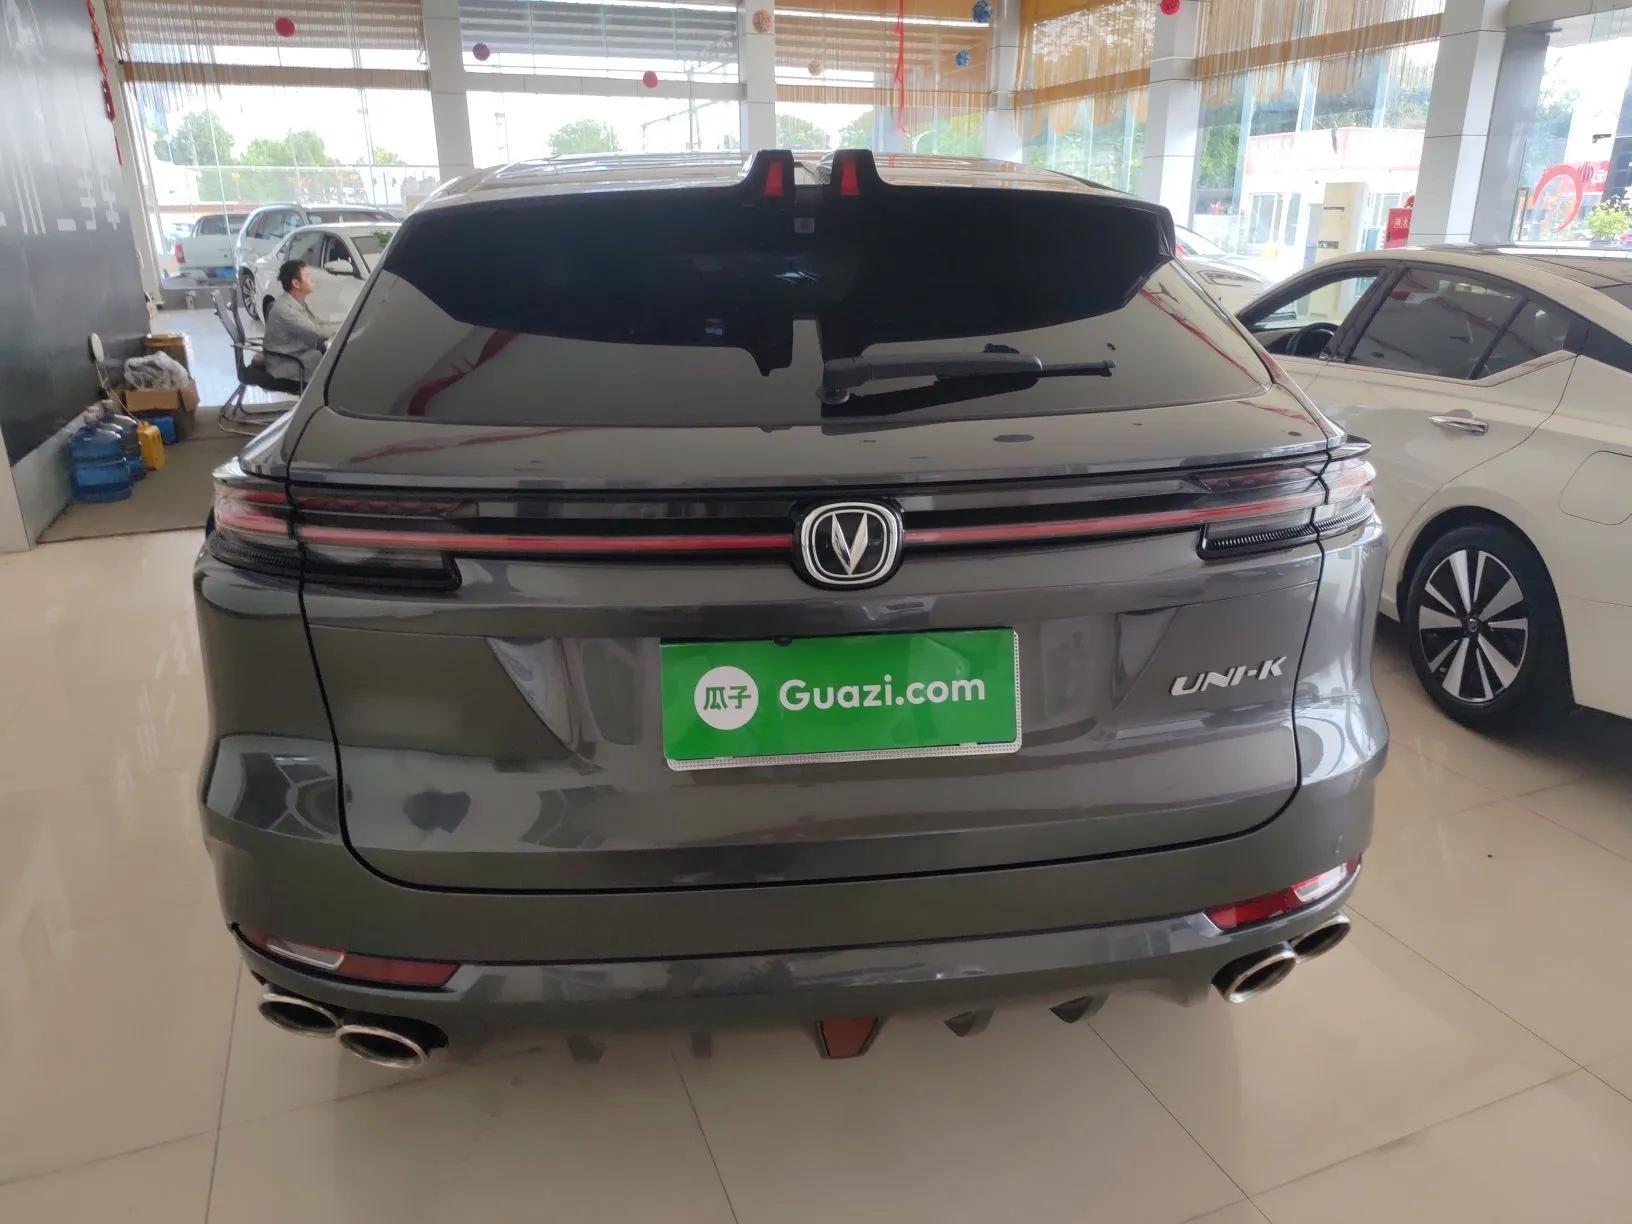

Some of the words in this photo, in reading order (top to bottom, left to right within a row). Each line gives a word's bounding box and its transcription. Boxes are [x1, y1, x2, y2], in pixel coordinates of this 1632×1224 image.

[779, 673, 986, 712] Guazi.com
[1170, 656, 1288, 696] UNI-K
[703, 685, 752, 711] 瓜子
